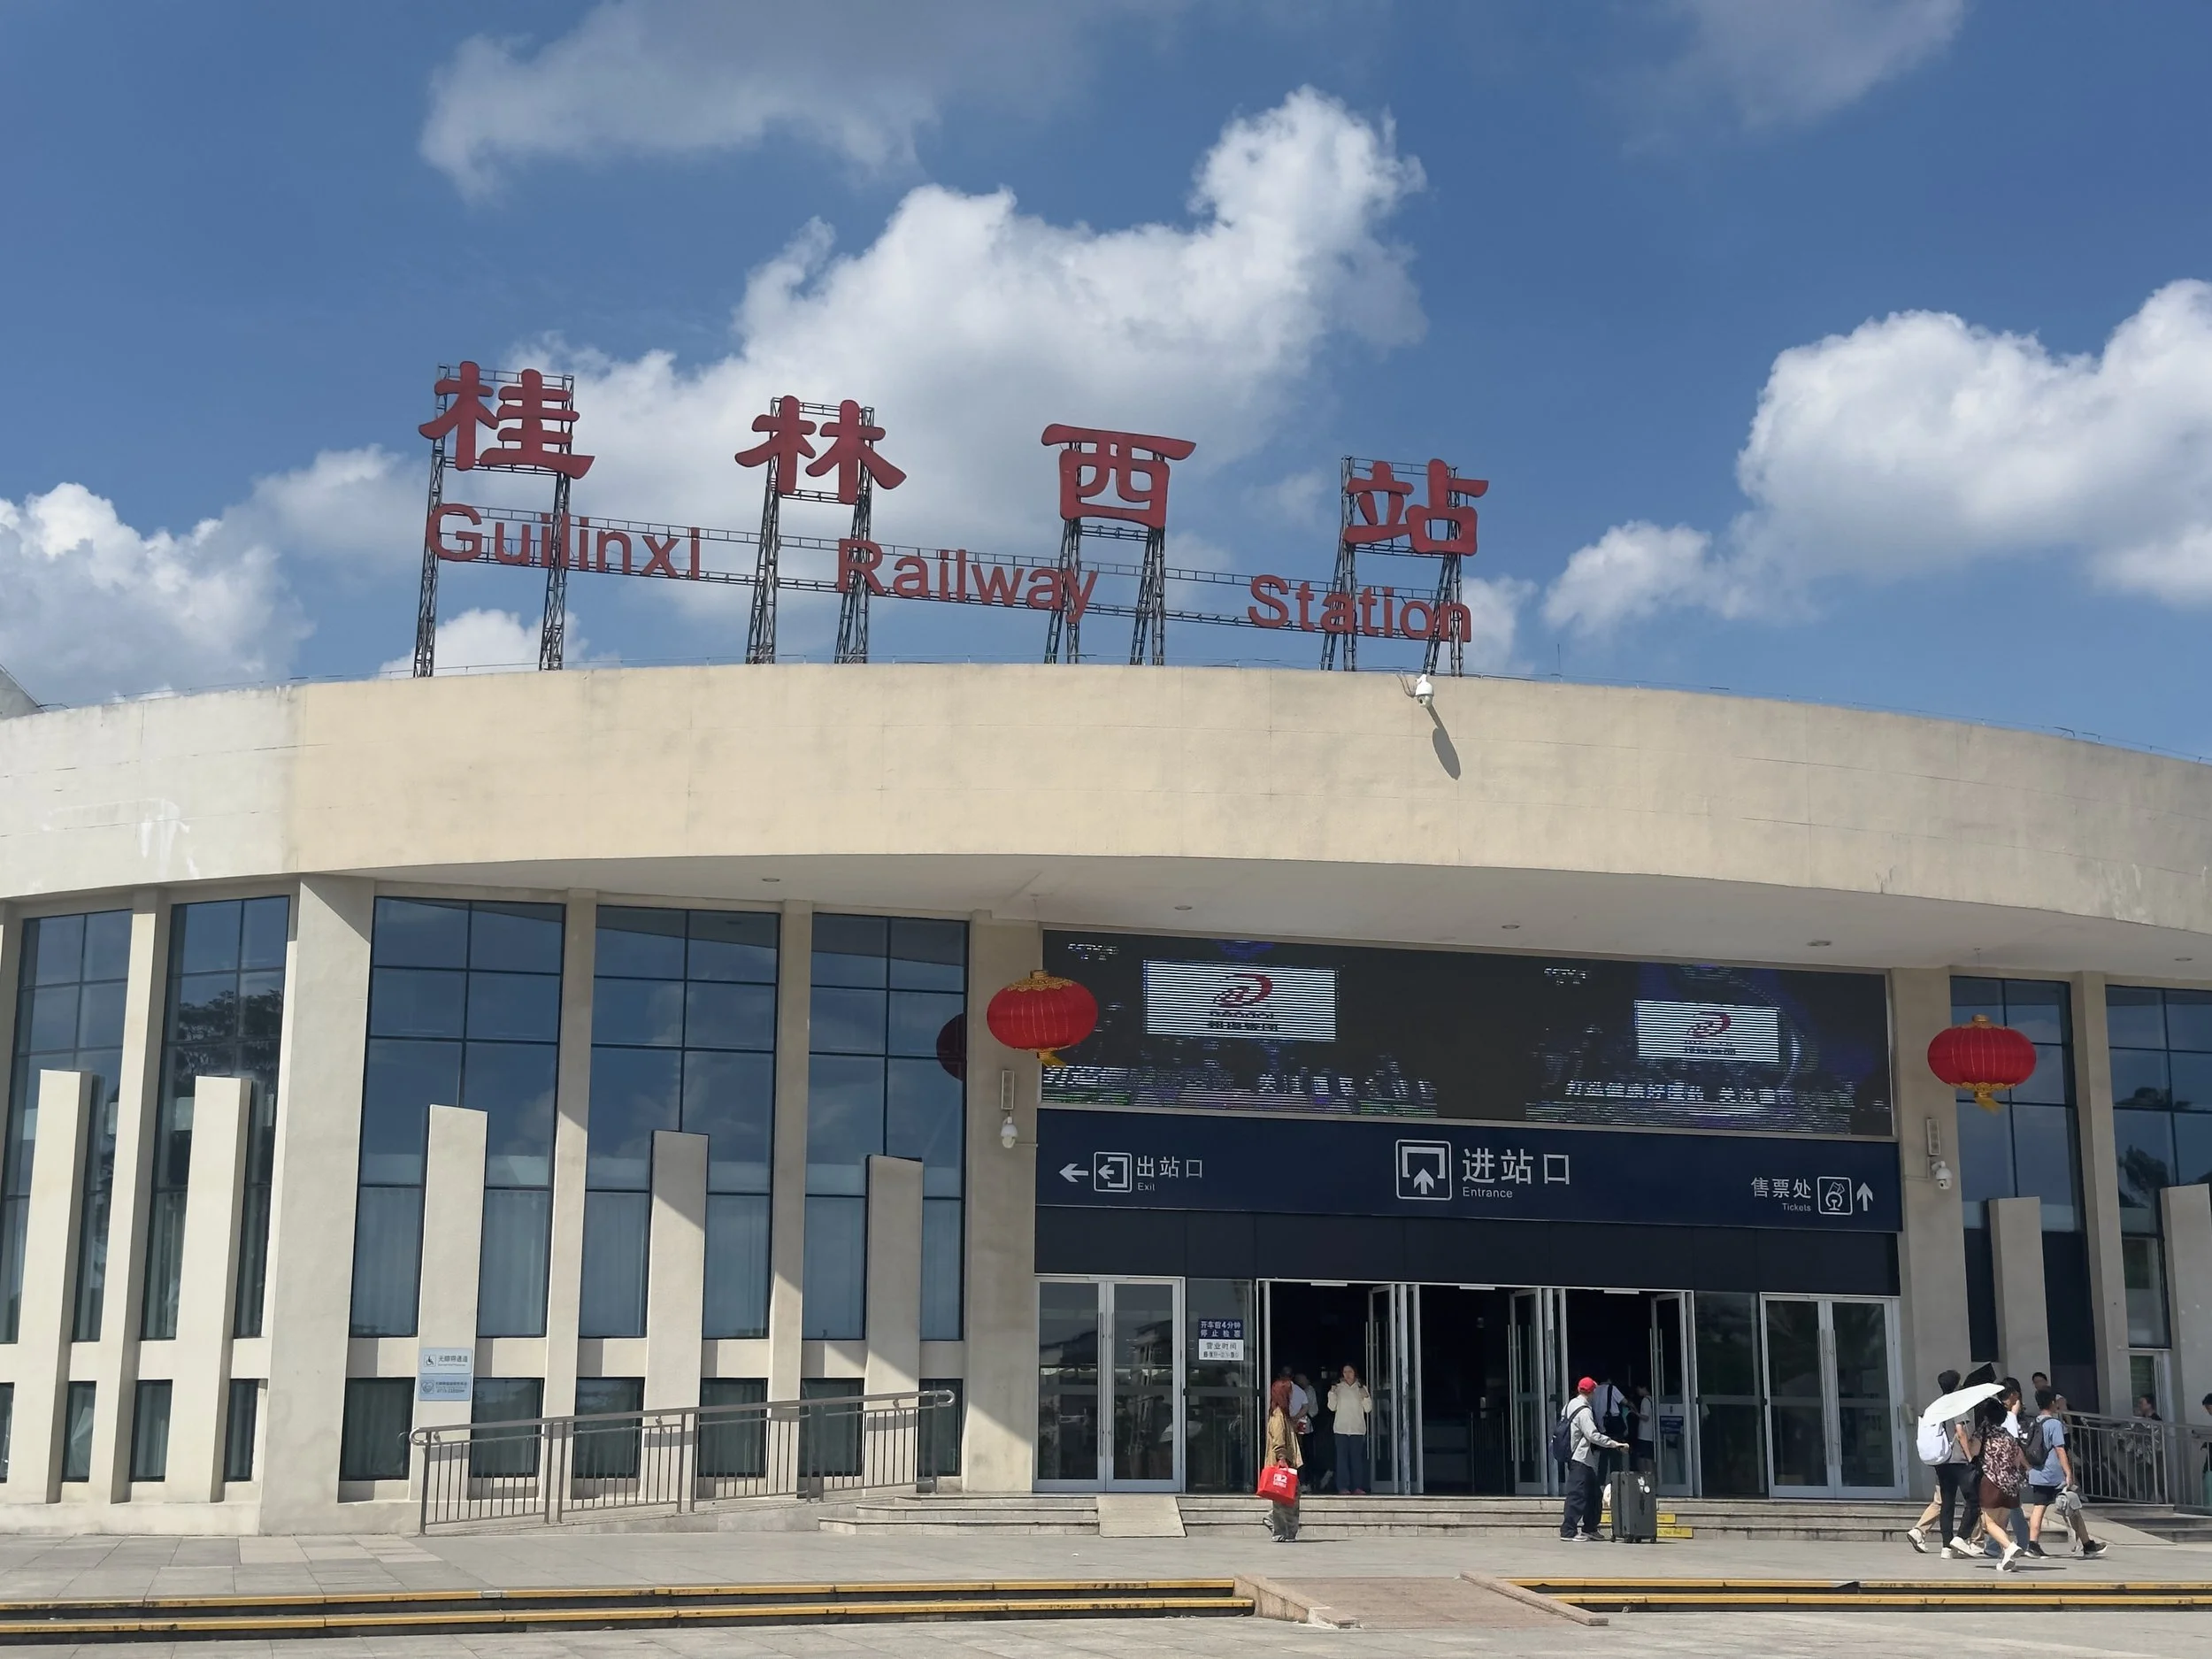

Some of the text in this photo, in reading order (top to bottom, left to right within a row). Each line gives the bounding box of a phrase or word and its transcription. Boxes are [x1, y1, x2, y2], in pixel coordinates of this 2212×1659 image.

[419, 361, 1489, 557] 桂林西站
[426, 503, 1471, 643] Guilinxi Railway Station
[1136, 1155, 1202, 1179] 出站口
[1462, 1148, 1571, 1186] 进站口
[1137, 1182, 1156, 1192] Exit
[1463, 1187, 1514, 1199] Entrance
[1750, 1177, 1812, 1200] 售票处
[1782, 1202, 1812, 1212] Tickets
[1200, 1320, 1241, 1329] 开车前4分钟
